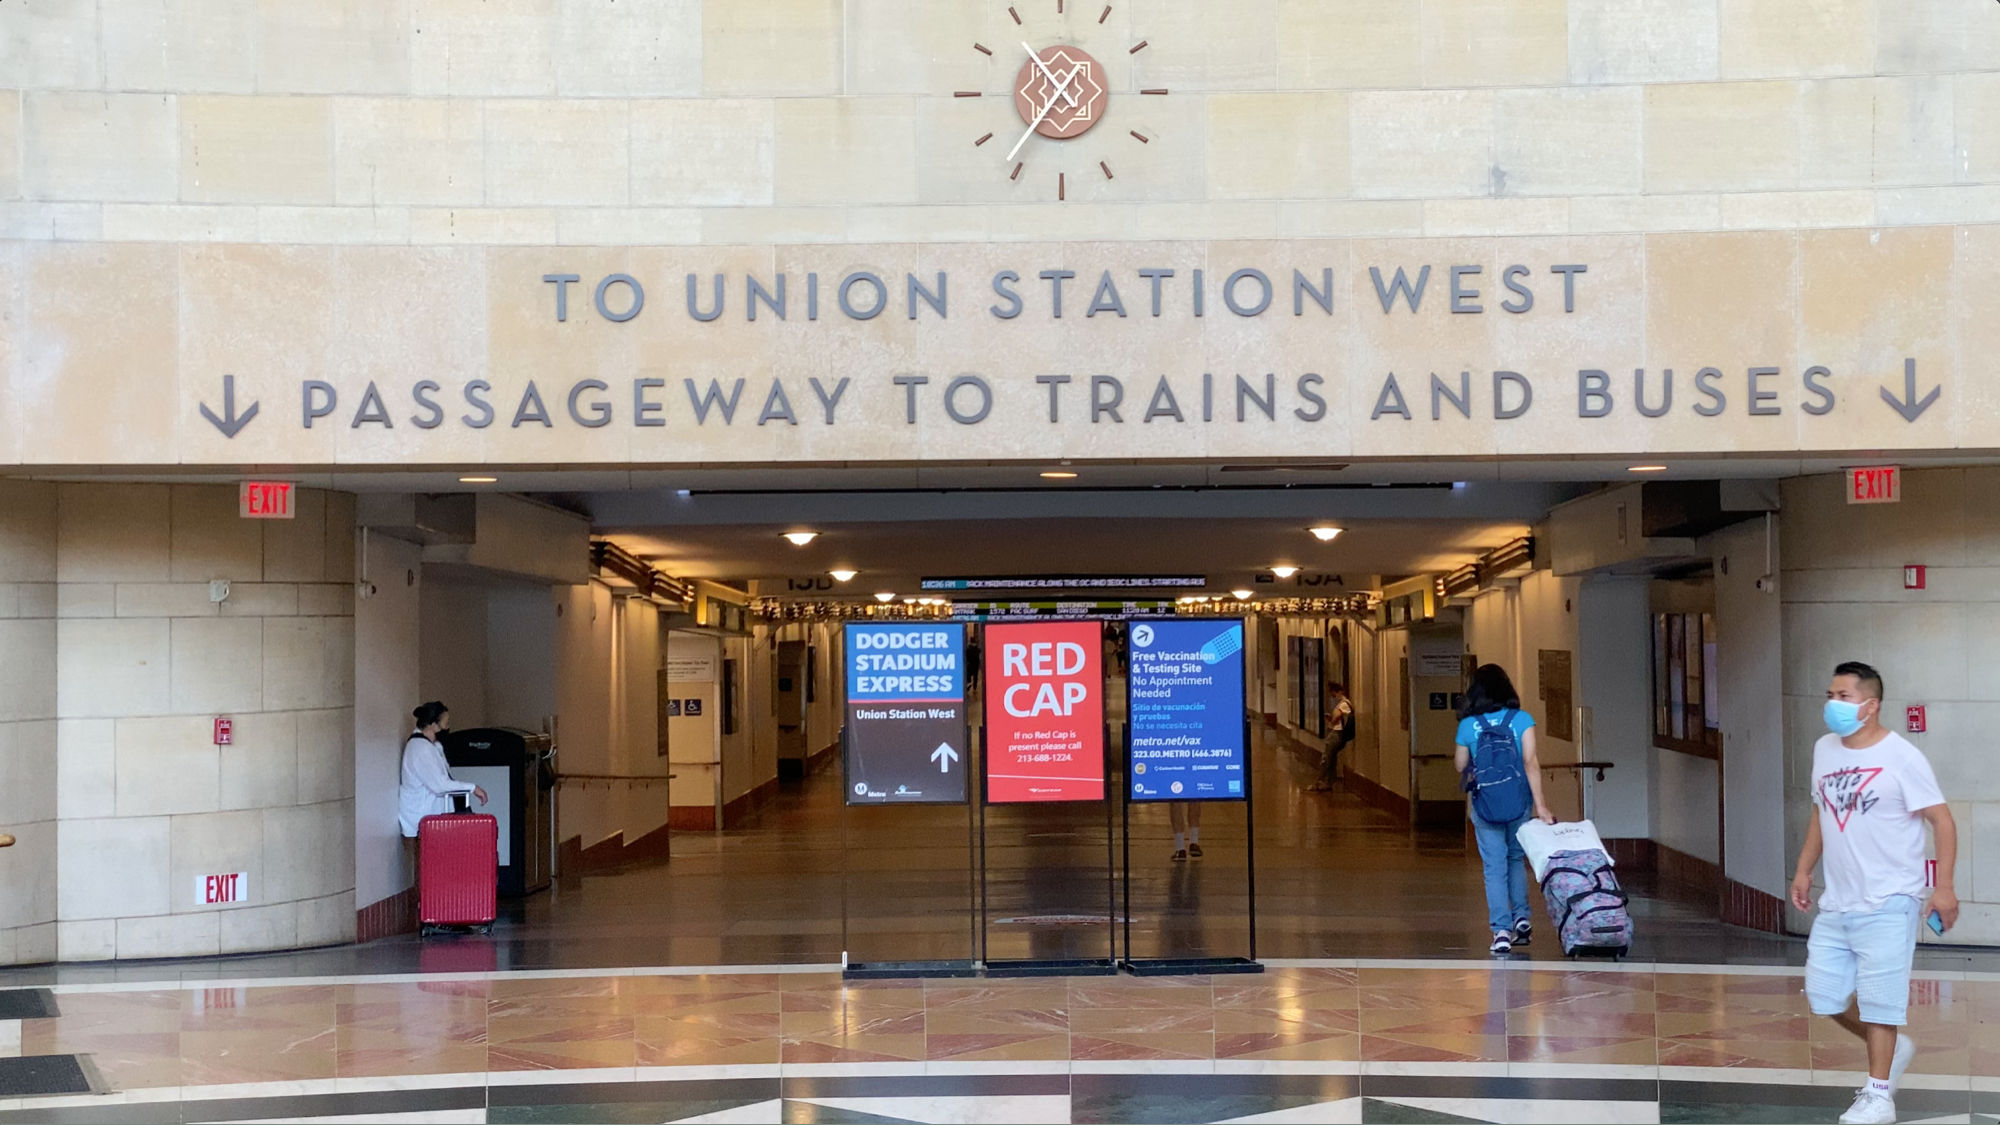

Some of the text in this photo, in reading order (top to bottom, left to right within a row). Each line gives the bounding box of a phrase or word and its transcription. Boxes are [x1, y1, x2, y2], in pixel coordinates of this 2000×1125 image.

[542, 264, 1588, 323] TO UNION STATION WEST
[303, 366, 1835, 430] PASSAGEWAY TO TRAINS AND BUSES
[1854, 469, 1894, 499] EXIT
[249, 483, 290, 514] EXIT
[856, 632, 949, 649] DODGER
[1003, 642, 1086, 677] RED
[1132, 650, 1215, 661] Free Vaccination
[856, 654, 956, 671] STADIUM
[1132, 662, 1202, 675] & Testing Site
[857, 675, 953, 692] EXPRESS
[1133, 675, 1213, 688] No Appointment
[1133, 687, 1171, 698] Needed
[1003, 682, 1087, 718] CAP
[856, 708, 956, 719] Union Station West
[1152, 703, 1162, 711] de
[1139, 712, 1171, 722] pruebas
[1014, 731, 1020, 740] If
[1035, 731, 1051, 739] Red
[1052, 730, 1068, 740] Cap
[1070, 730, 1076, 738] is
[1133, 735, 1202, 747] metro.net/vax
[1008, 741, 1082, 752] present please call
[1133, 749, 1191, 759] 323.GO.METRO
[206, 873, 239, 903] EXIT
